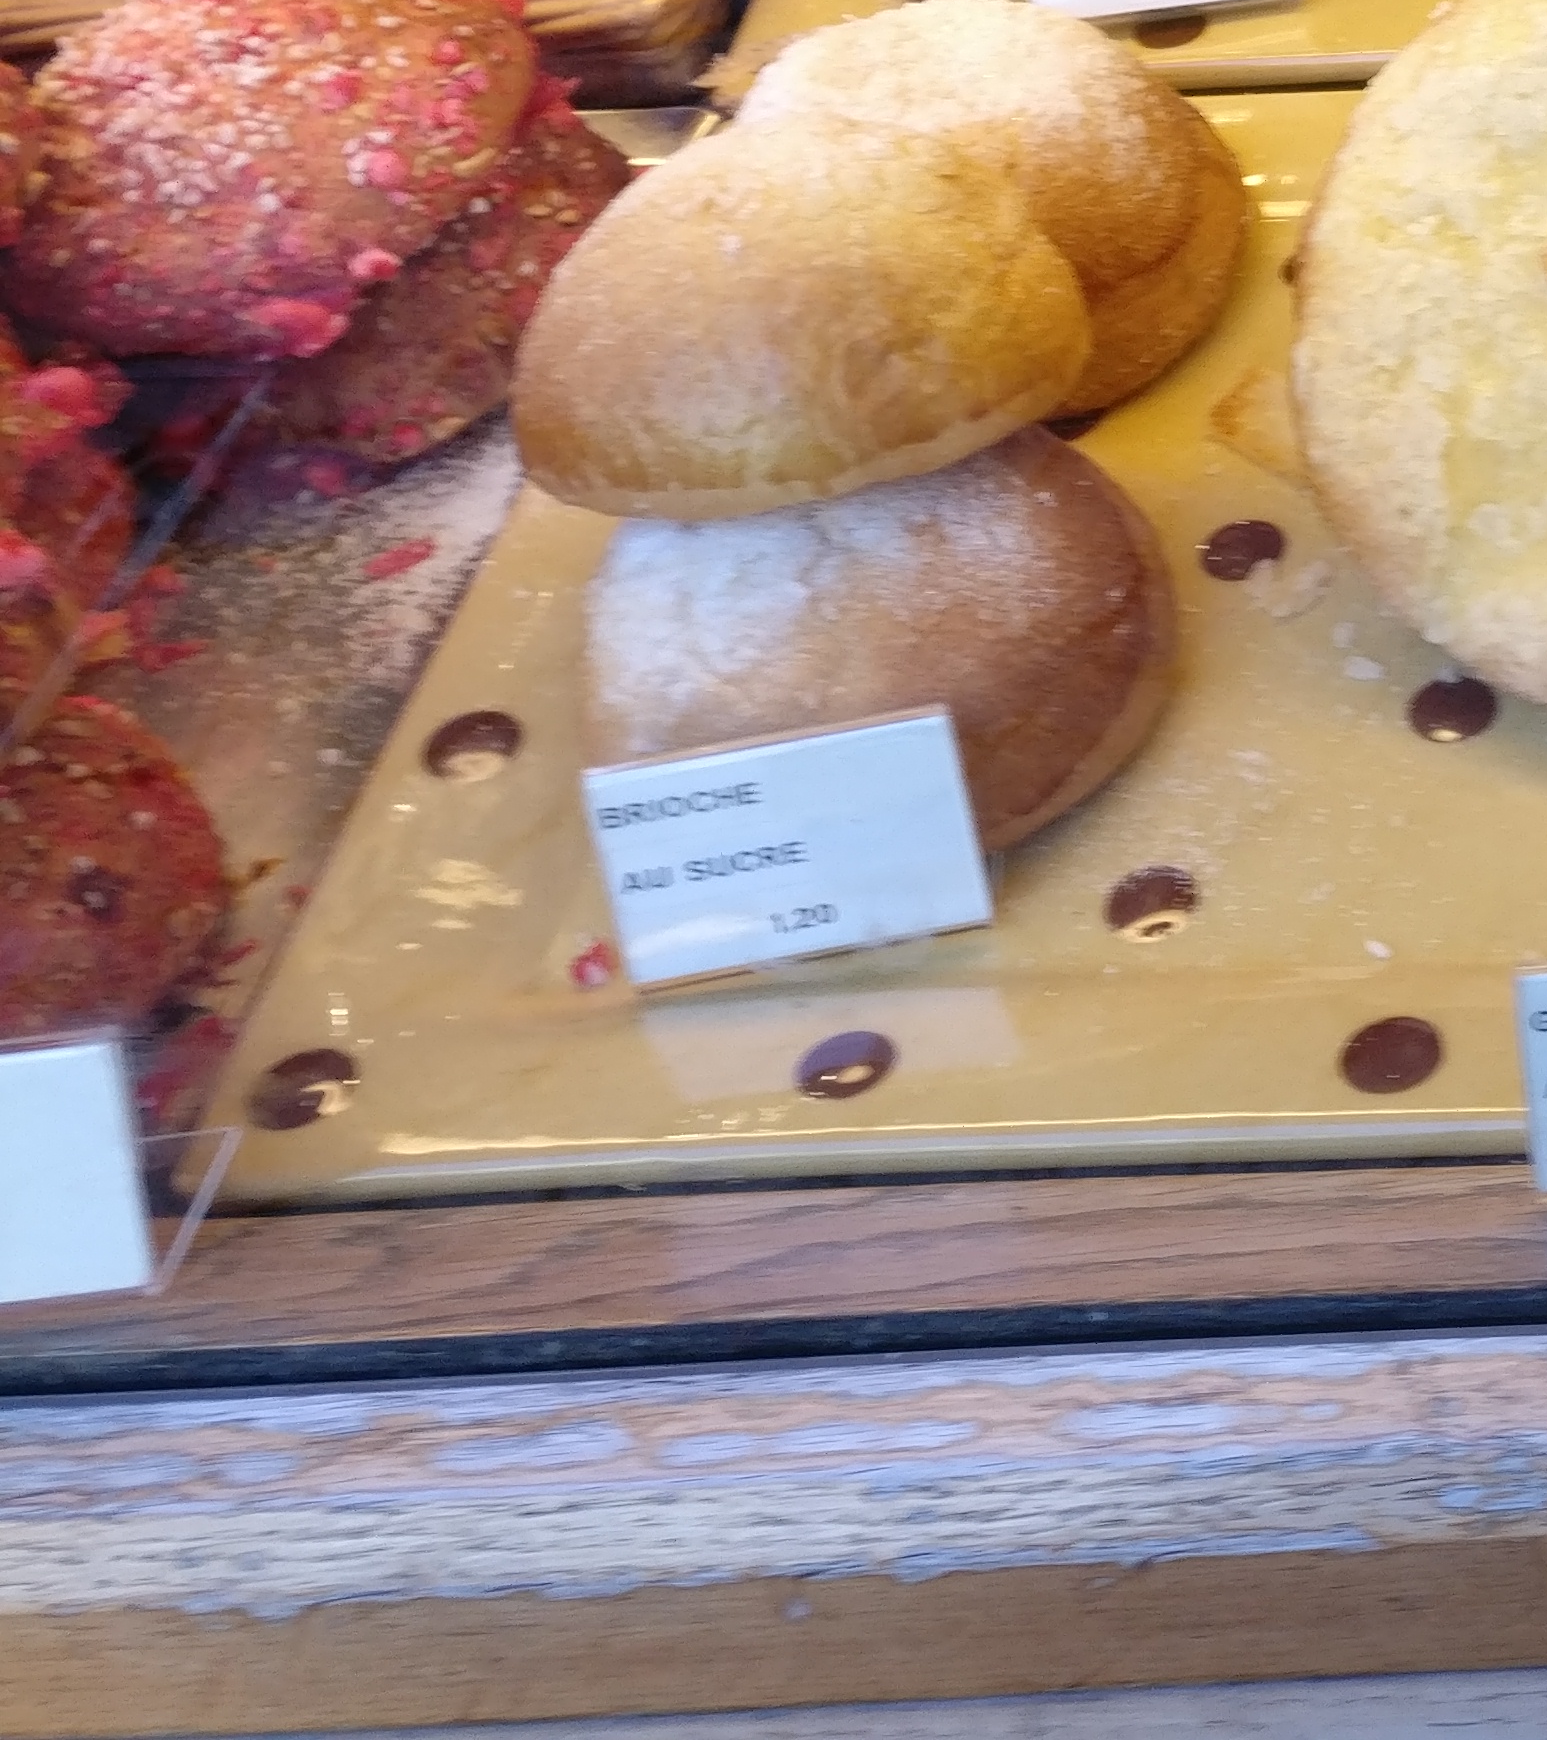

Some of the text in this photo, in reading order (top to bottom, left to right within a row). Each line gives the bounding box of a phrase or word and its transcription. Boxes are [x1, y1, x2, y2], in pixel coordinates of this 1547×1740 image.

[597, 782, 764, 829] BRIOCHE
[621, 841, 809, 894] AU SUCRE
